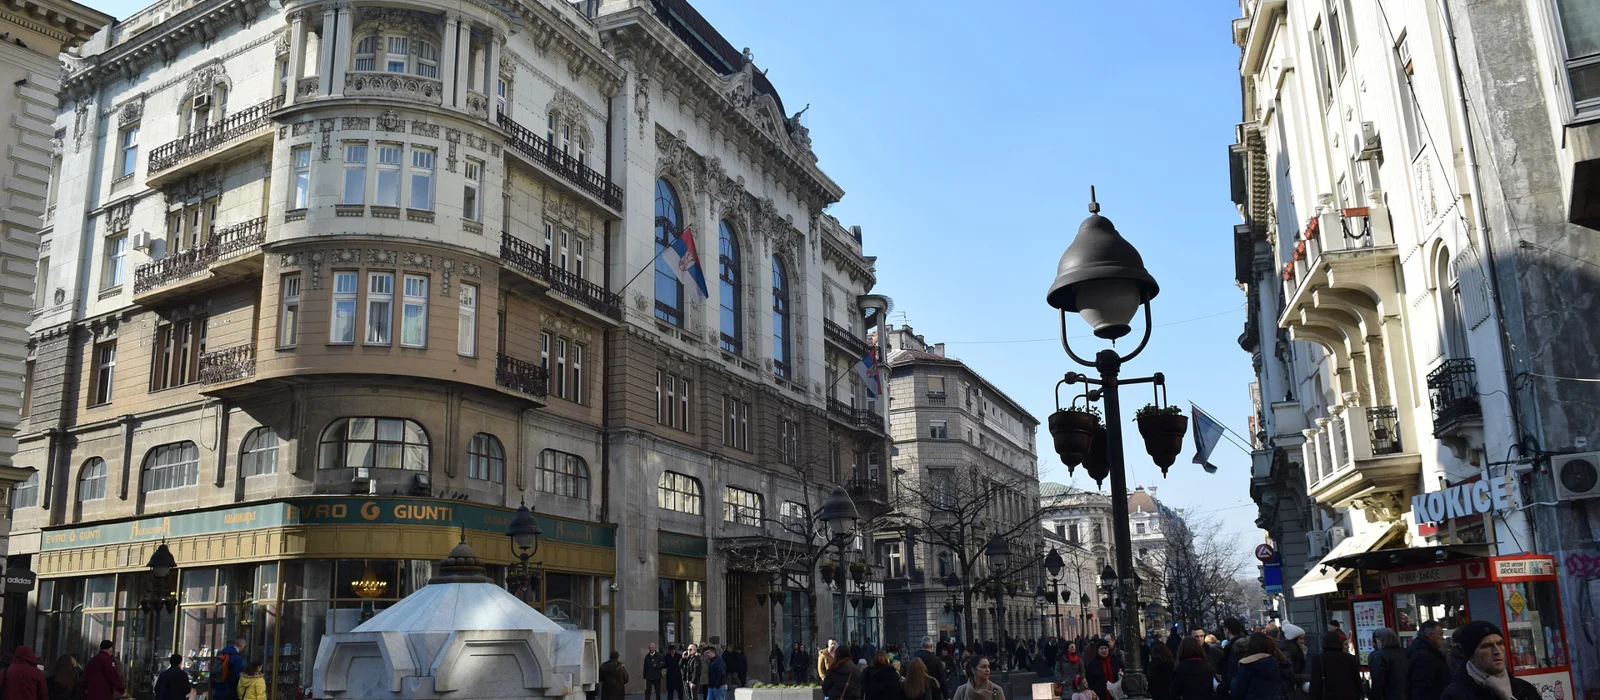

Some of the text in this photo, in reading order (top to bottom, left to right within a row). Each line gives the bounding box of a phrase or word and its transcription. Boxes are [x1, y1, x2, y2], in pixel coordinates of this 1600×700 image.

[1412, 476, 1513, 525] KOKICE
[394, 504, 453, 521] GIUNTI
[79, 530, 100, 540] GIUNTI
